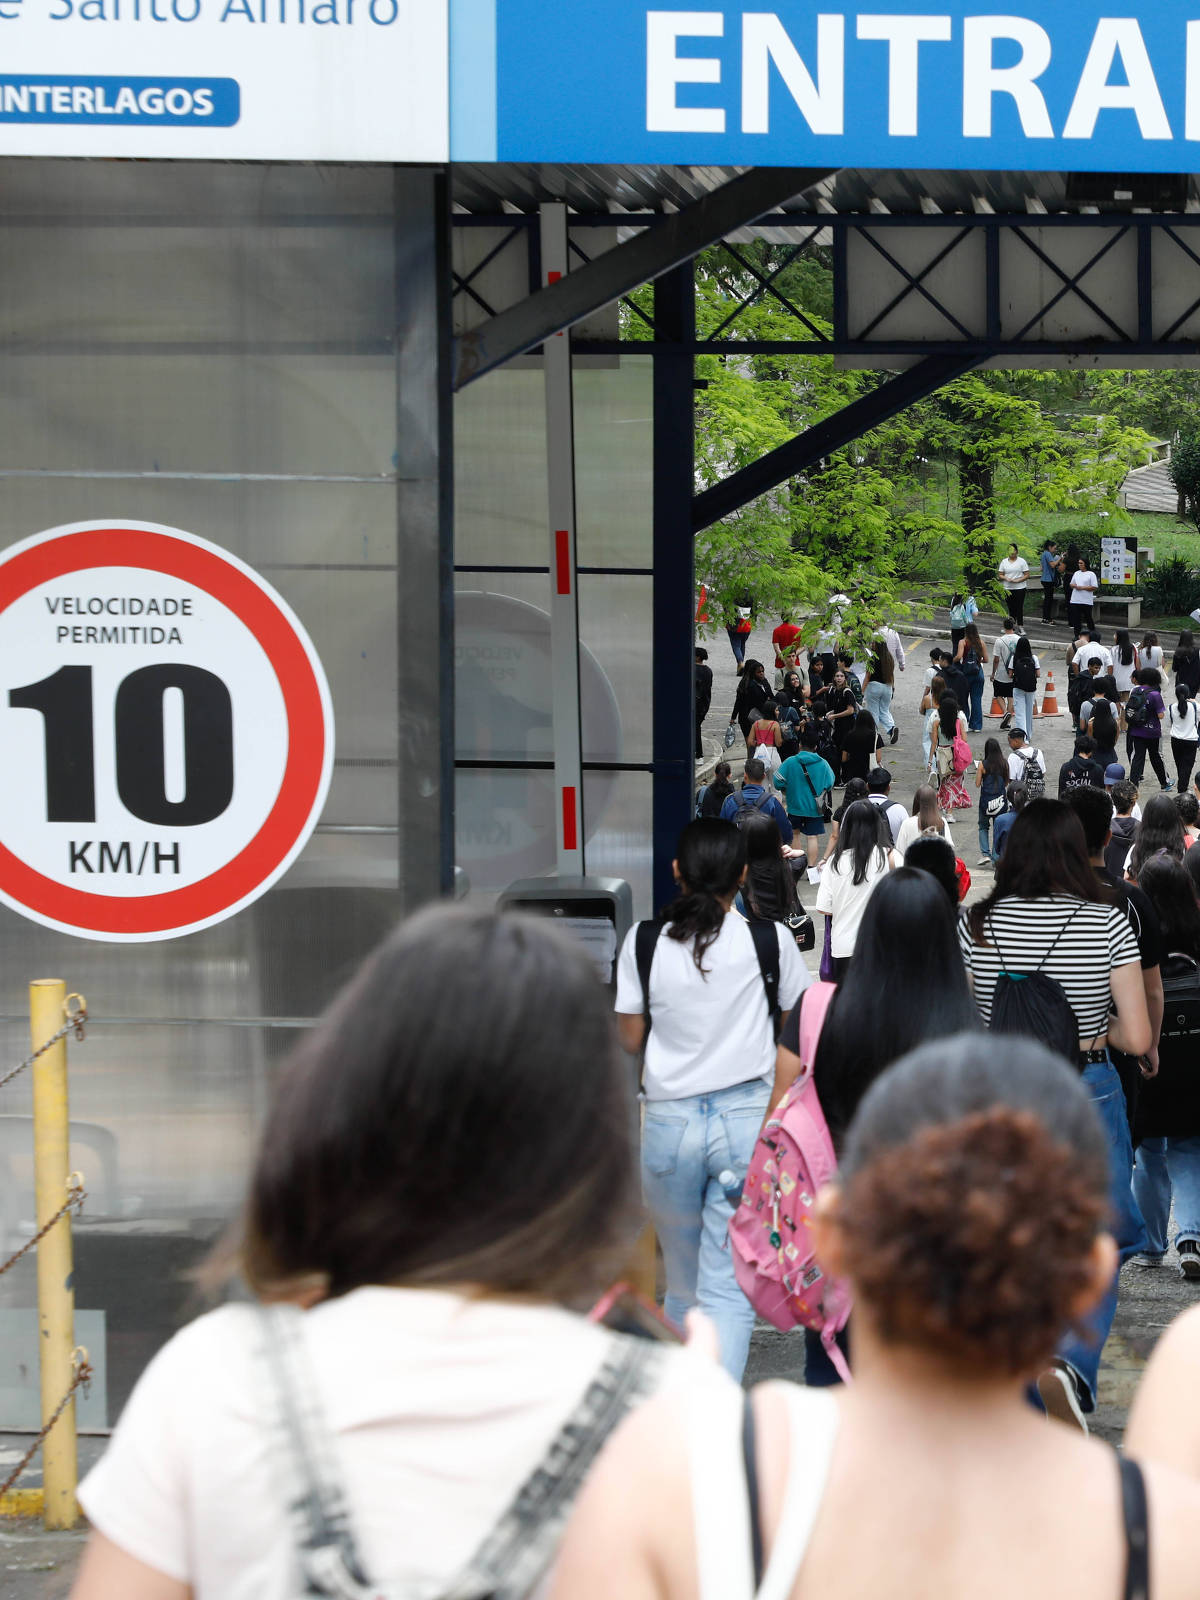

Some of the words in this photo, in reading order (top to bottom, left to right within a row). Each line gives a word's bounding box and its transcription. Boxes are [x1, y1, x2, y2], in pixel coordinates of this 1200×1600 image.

[0, 85, 215, 116] NTERLAGOS
[45, 597, 194, 616] VELOCIDADE
[57, 626, 183, 645] PERMITIDA
[8, 663, 235, 828] 10
[69, 841, 181, 875] KM/H
